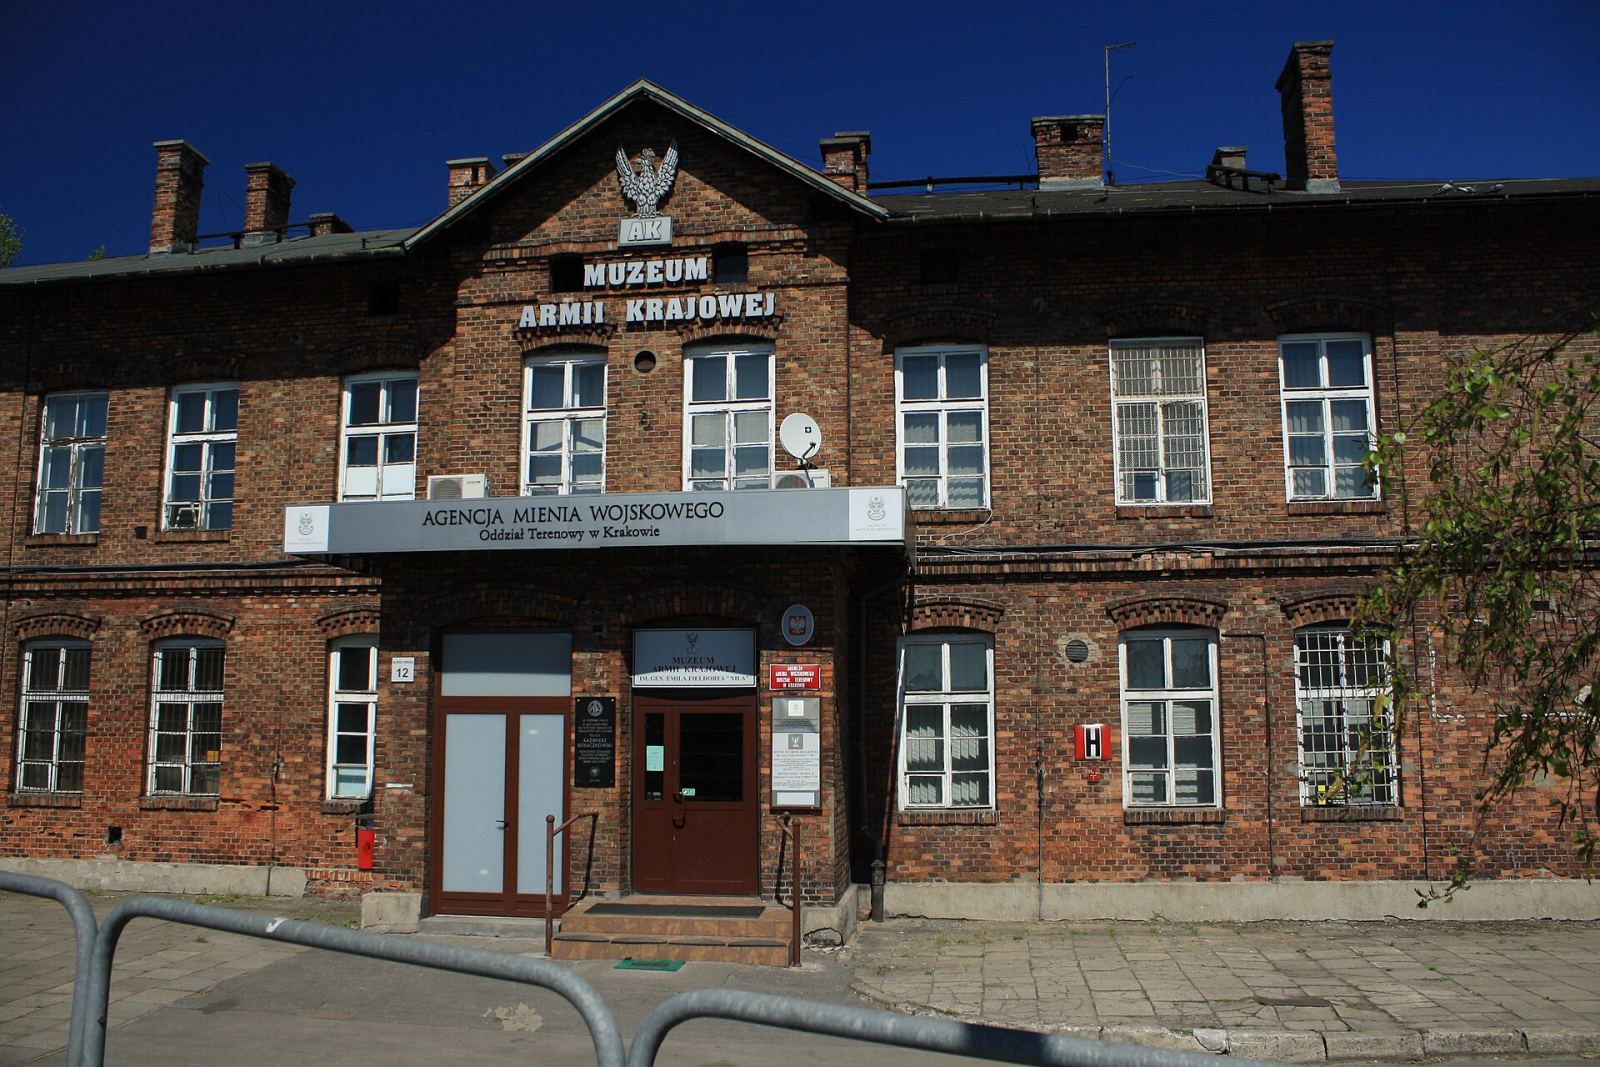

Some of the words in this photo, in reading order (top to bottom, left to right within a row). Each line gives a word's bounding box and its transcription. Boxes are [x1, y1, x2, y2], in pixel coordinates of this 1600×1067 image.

[628, 221, 661, 241] AK
[583, 257, 708, 287] MUZEUM
[519, 301, 605, 328] ARMII
[626, 293, 776, 323] KRAJOWEJ
[422, 508, 504, 528] AGENCJA
[513, 506, 582, 524] MIENIA
[589, 501, 724, 525] WOJSKOWEGO
[479, 528, 524, 541] Oddział
[528, 528, 585, 542] Terenowy
[589, 530, 600, 539] w
[602, 525, 660, 538] Krakowie
[652, 665, 680, 673] ARMII
[684, 664, 736, 673] KRAJOWEJ
[672, 656, 715, 665] MUZEUM
[396, 667, 409, 678] 12
[1085, 727, 1101, 757] H
